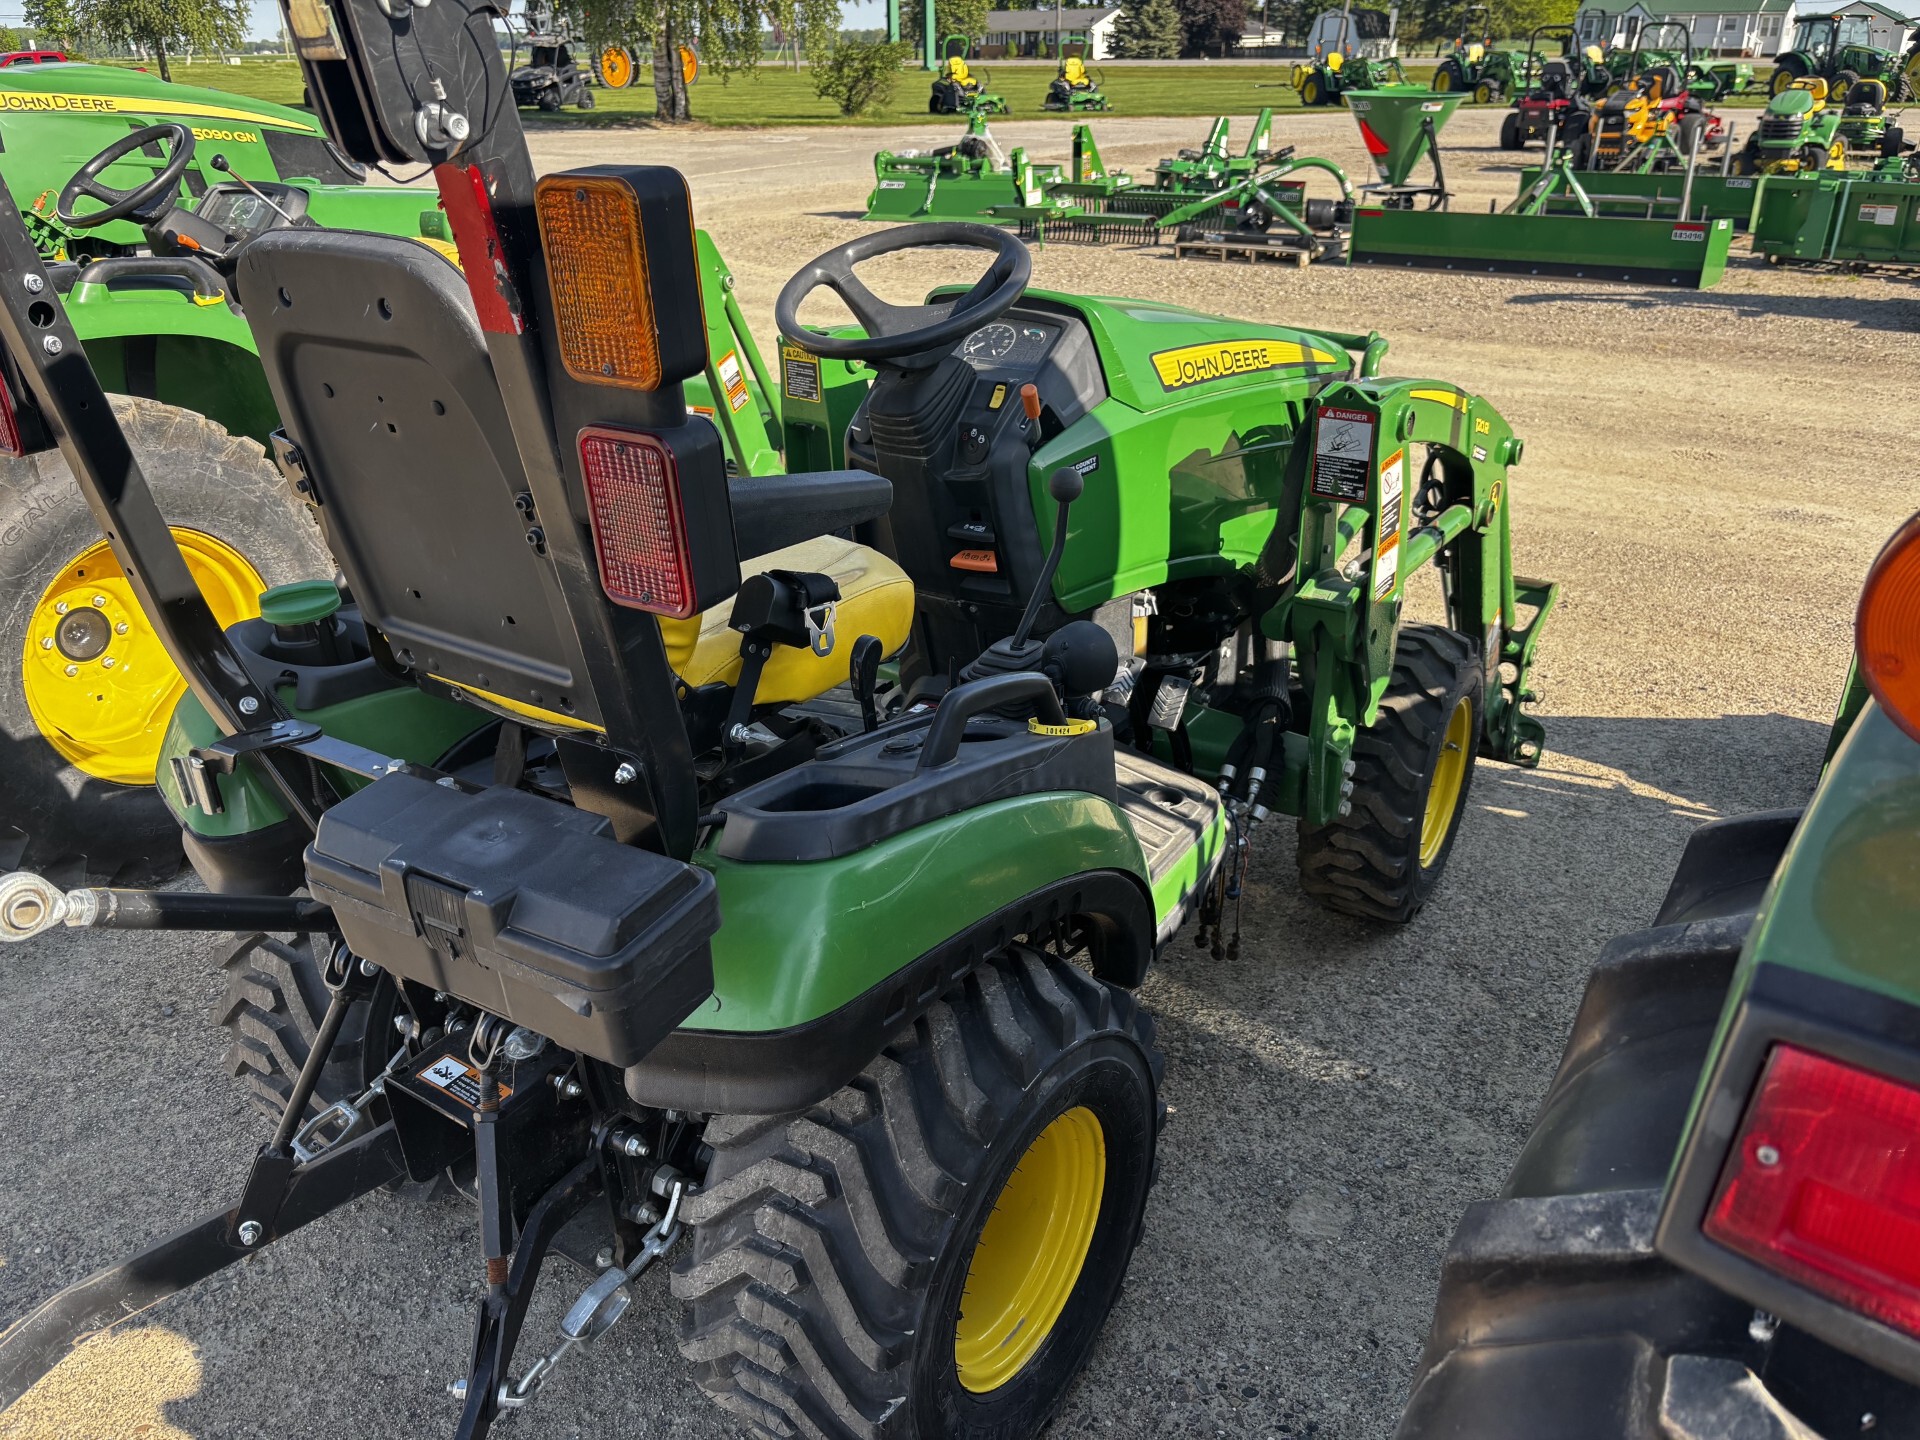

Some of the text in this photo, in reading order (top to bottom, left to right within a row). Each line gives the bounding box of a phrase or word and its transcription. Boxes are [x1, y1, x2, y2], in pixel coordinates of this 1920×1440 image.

[0, 95, 117, 111] JOHN DEERE
[192, 128, 258, 144] 5090 GN
[1174, 347, 1271, 383] JOHN DEERE
[1336, 411, 1368, 421] DANGER
[1076, 456, 1097, 470] COUNTY
[1046, 727, 1070, 735] 101424
